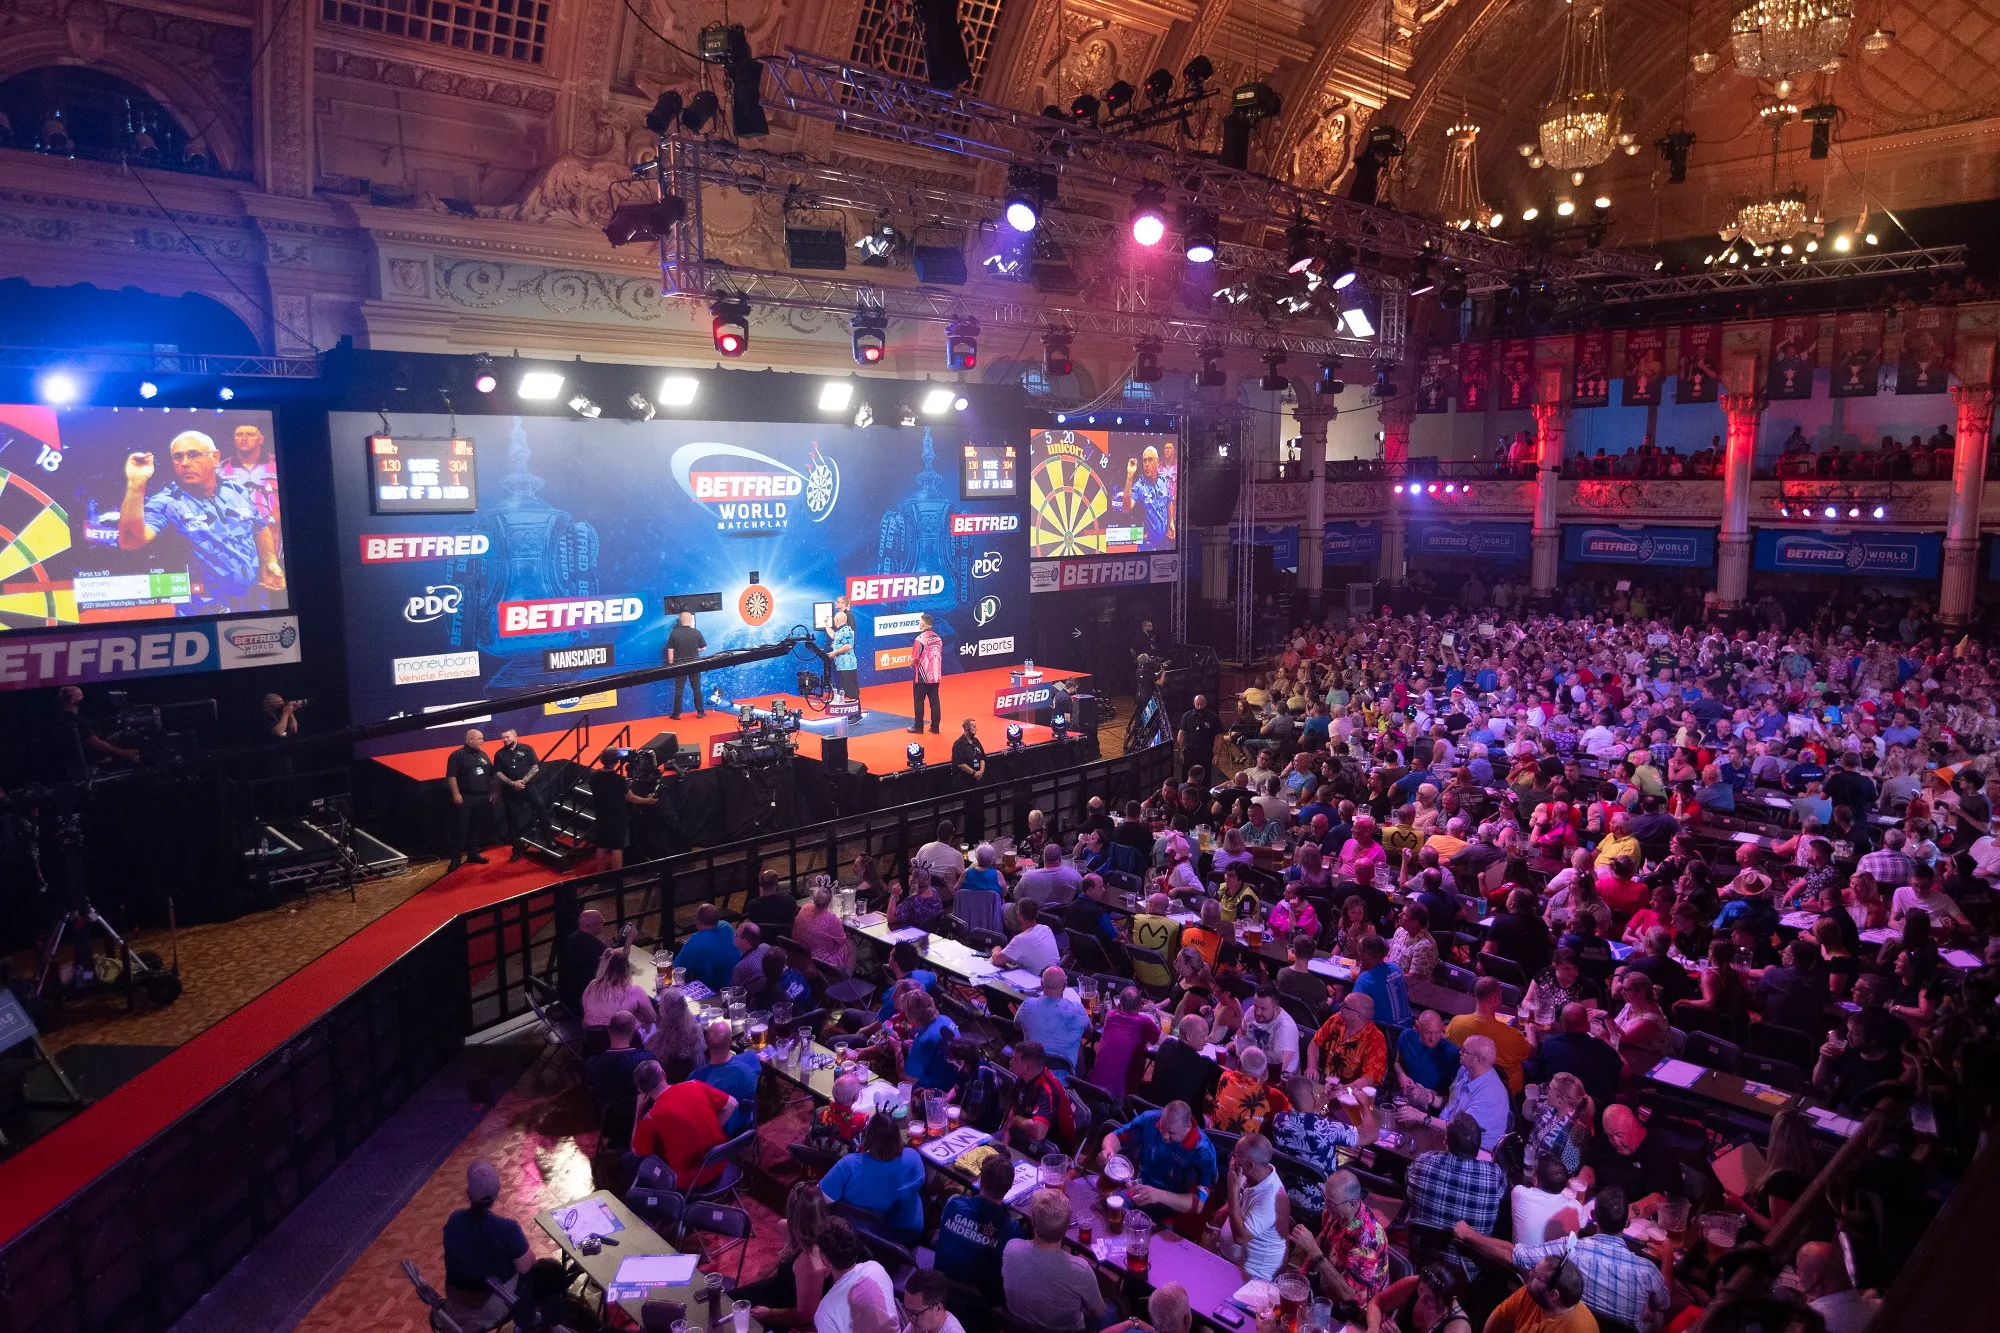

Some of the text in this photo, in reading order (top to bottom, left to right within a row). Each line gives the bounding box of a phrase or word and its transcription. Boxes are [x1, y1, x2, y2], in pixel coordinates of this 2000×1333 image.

[1045, 430, 1075, 444] 5 20
[36, 443, 62, 470] 18
[968, 460, 979, 470] 130
[1002, 460, 1013, 470] 304
[1099, 453, 1108, 469] 18
[382, 460, 401, 472] 130
[449, 460, 468, 472] 304
[696, 476, 803, 498] BETFRED
[719, 502, 787, 519] WORLD
[718, 519, 789, 530] MATCHPLAY
[954, 515, 1018, 533] BETFRED
[367, 534, 489, 559] BETFRED
[1429, 537, 1510, 546] BETFRED WORLD
[1590, 541, 1689, 552] BETFRED WORLD
[1786, 548, 1908, 560] BETFRED WORLD
[974, 558, 1000, 574] PDC
[1063, 560, 1148, 585] BETFRED
[80, 580, 110, 589] Gurney
[171, 575, 186, 583] 130
[851, 575, 945, 602] BETFRED
[409, 594, 458, 616] PDC
[506, 597, 644, 631] BETFRED
[879, 620, 920, 630] TOYO TIRES
[234, 634, 281, 645] BETFRED
[245, 643, 274, 651] WORLD
[960, 639, 1013, 657] sky sports
[0, 632, 210, 683] ETFRED
[398, 655, 477, 672] moneybarn
[550, 648, 607, 669] MANSCAPED
[891, 655, 907, 664] JUST
[399, 669, 477, 683] Vehicle Finance
[996, 689, 1050, 709] BETFRED
[932, 1132, 979, 1158] MVG
[954, 1213, 979, 1231] GARY
[944, 1219, 999, 1248] ANDERSON
